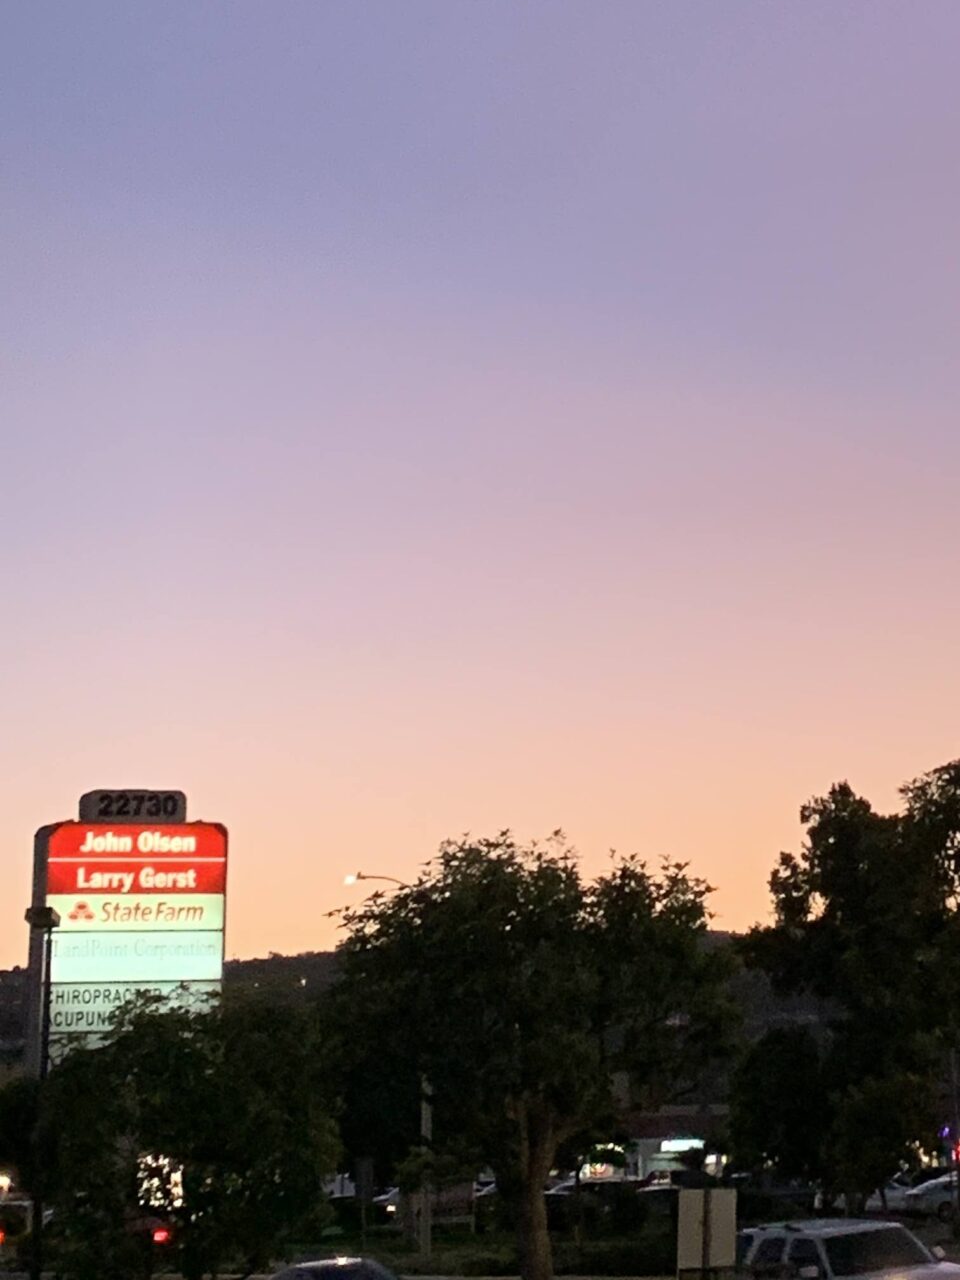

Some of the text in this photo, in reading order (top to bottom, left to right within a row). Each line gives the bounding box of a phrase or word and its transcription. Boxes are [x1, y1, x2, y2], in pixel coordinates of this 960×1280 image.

[98, 793, 179, 817] 22730
[79, 831, 197, 853] John Olsen
[77, 867, 197, 894] Larry Gerst
